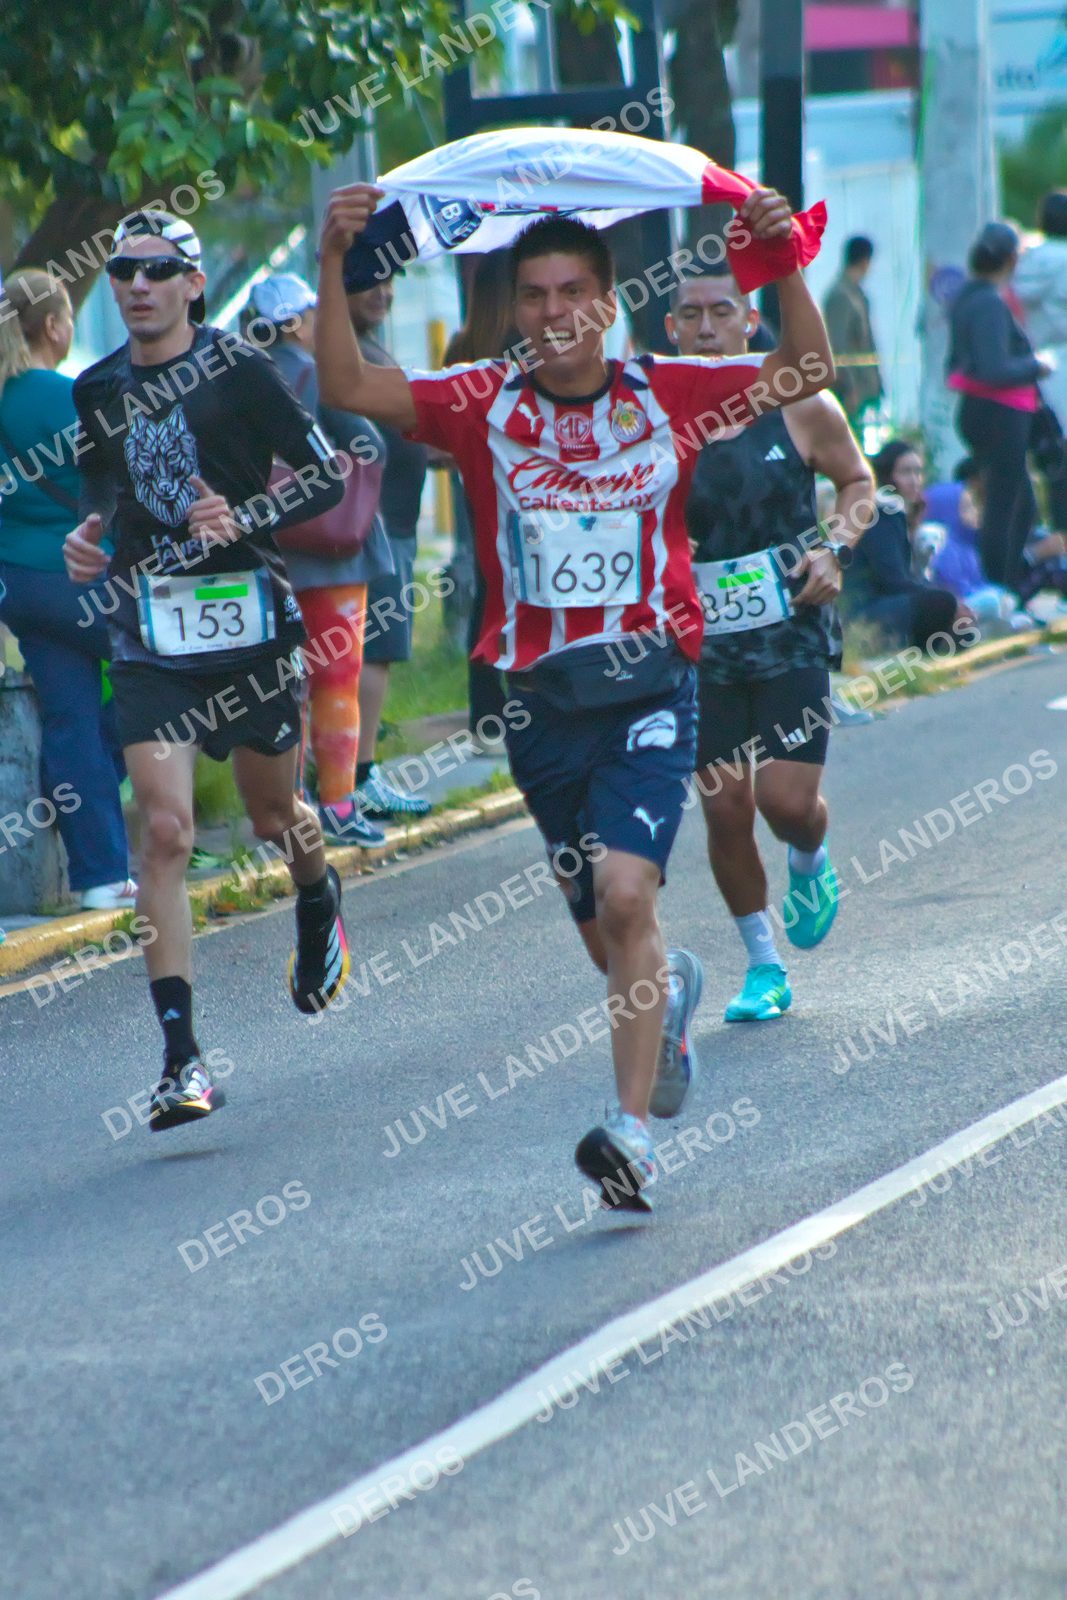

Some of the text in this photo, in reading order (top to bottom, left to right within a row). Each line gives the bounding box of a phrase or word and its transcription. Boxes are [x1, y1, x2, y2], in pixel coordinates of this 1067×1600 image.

[557, 412, 591, 441] MG
[508, 455, 655, 493] Caliente
[151, 535, 172, 549] LA
[530, 551, 634, 594] 1639
[173, 601, 245, 642] 153
